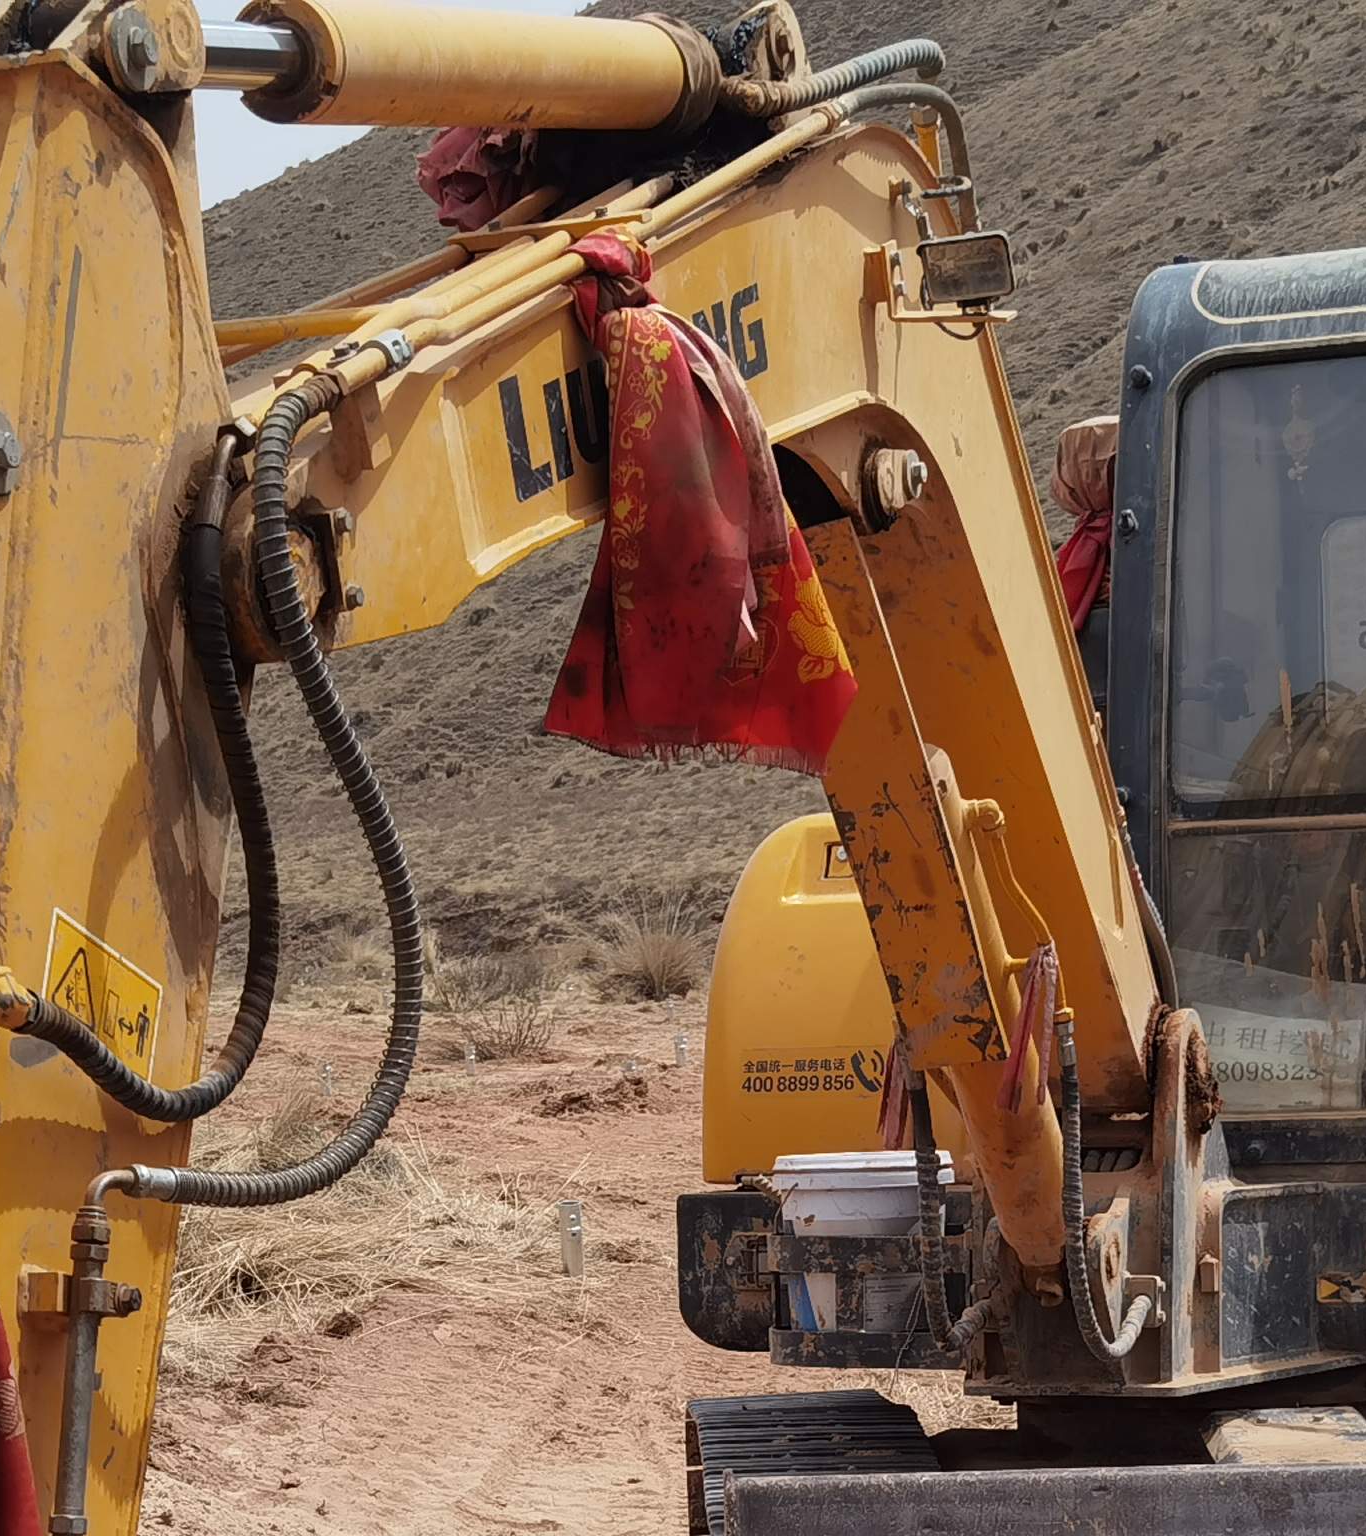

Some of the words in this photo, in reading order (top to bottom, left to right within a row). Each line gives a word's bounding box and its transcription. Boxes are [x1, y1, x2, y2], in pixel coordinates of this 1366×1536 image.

[498, 283, 769, 502] LIUNG
[743, 1058, 846, 1074] 全国统一服务电话
[742, 1076, 773, 1093] 400
[777, 1075, 820, 1092] 8899
[822, 1073, 855, 1091] 856
